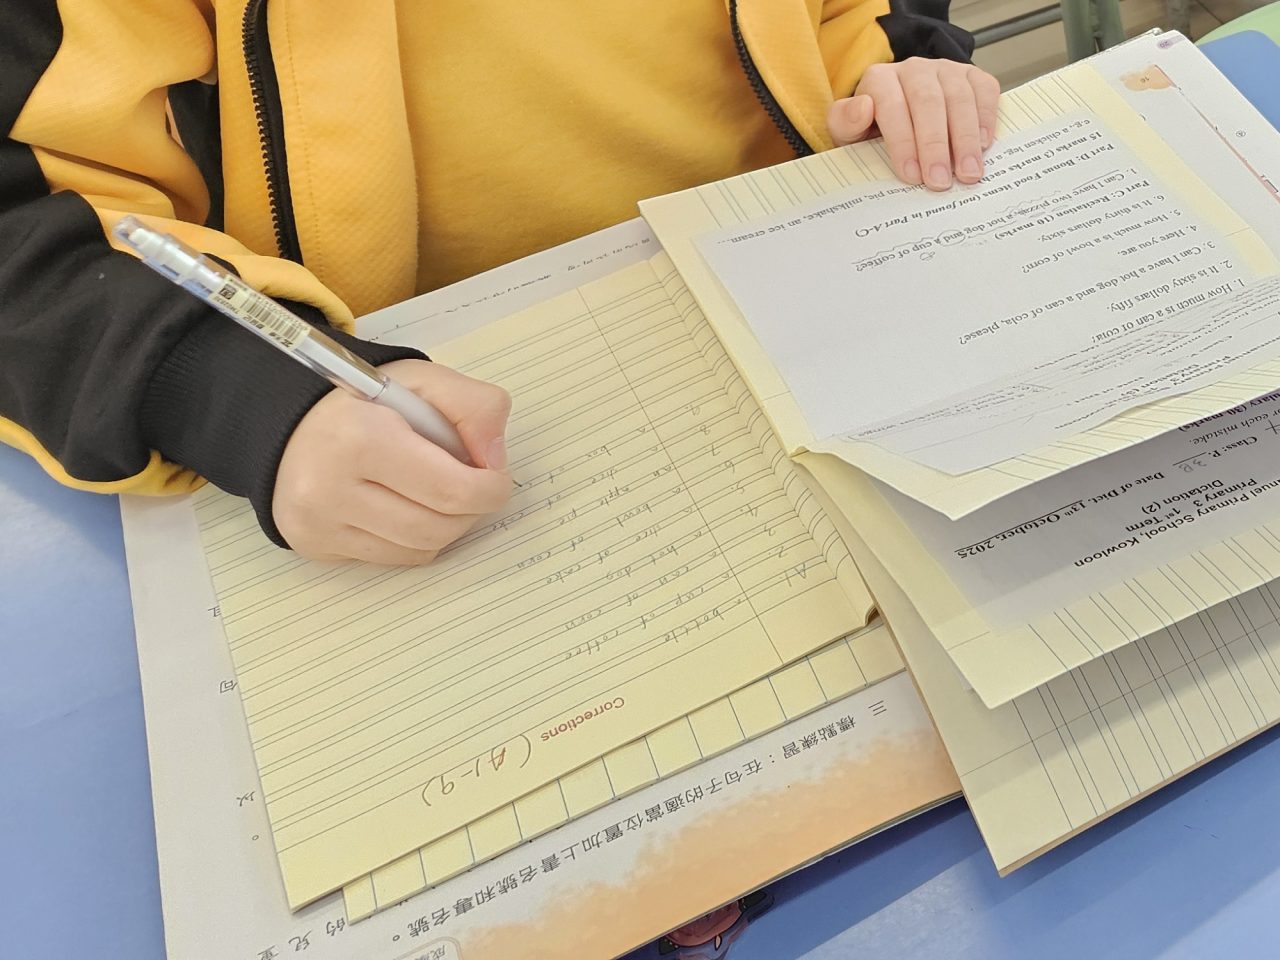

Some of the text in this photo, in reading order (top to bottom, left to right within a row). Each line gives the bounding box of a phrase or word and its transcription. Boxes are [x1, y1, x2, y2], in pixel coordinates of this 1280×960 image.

[1022, 130, 1061, 149] chicken
[1054, 135, 1087, 152] marks
[1088, 130, 1102, 141] 15
[1002, 145, 1024, 156] leg,
[1007, 154, 1042, 171] marks
[1042, 148, 1055, 159] (3
[854, 142, 1114, 238] Part D: Bonus Food items (not found in Part A-C)
[862, 189, 885, 200] pie,
[801, 196, 863, 220] milkshake,
[993, 179, 1150, 240] Part C: Recitation (10 marks)
[1036, 191, 1166, 242] 6. is thirty dollars sixty.
[766, 223, 786, 233] ice
[786, 217, 802, 227] an
[852, 170, 1126, 273] Can have two pizzas, hot dog and cup of coffee?
[1020, 213, 1169, 274] How much is bowl of corn?
[1116, 220, 1199, 256] 4. Here you are.
[958, 239, 1216, 345] 3. Can have hot dog and can of cola, please?
[1105, 258, 1233, 312] 2. It is sixty dollars fifty.
[1206, 282, 1233, 301] How
[1232, 277, 1245, 287] 1.
[1175, 292, 1207, 310] much
[1134, 312, 1155, 326] can
[1239, 412, 1269, 428] each
[1188, 423, 1238, 445] mistake.
[1206, 435, 1258, 462] Class: P.
[1119, 482, 1133, 493] of
[1131, 465, 1165, 491] Date
[1203, 477, 1257, 502] Primary
[1086, 488, 1119, 503] Dict.
[1140, 478, 1224, 515] Dictation (2)
[1189, 496, 1205, 510] 3
[1195, 486, 1250, 517] Primary
[993, 505, 1062, 549] October,
[1124, 515, 1161, 532] Term
[1138, 513, 1195, 539] School,
[954, 534, 996, 564] 2025
[1073, 535, 1140, 567] Kowloon
[659, 605, 726, 648] bottle
[539, 696, 625, 742] Corrections
